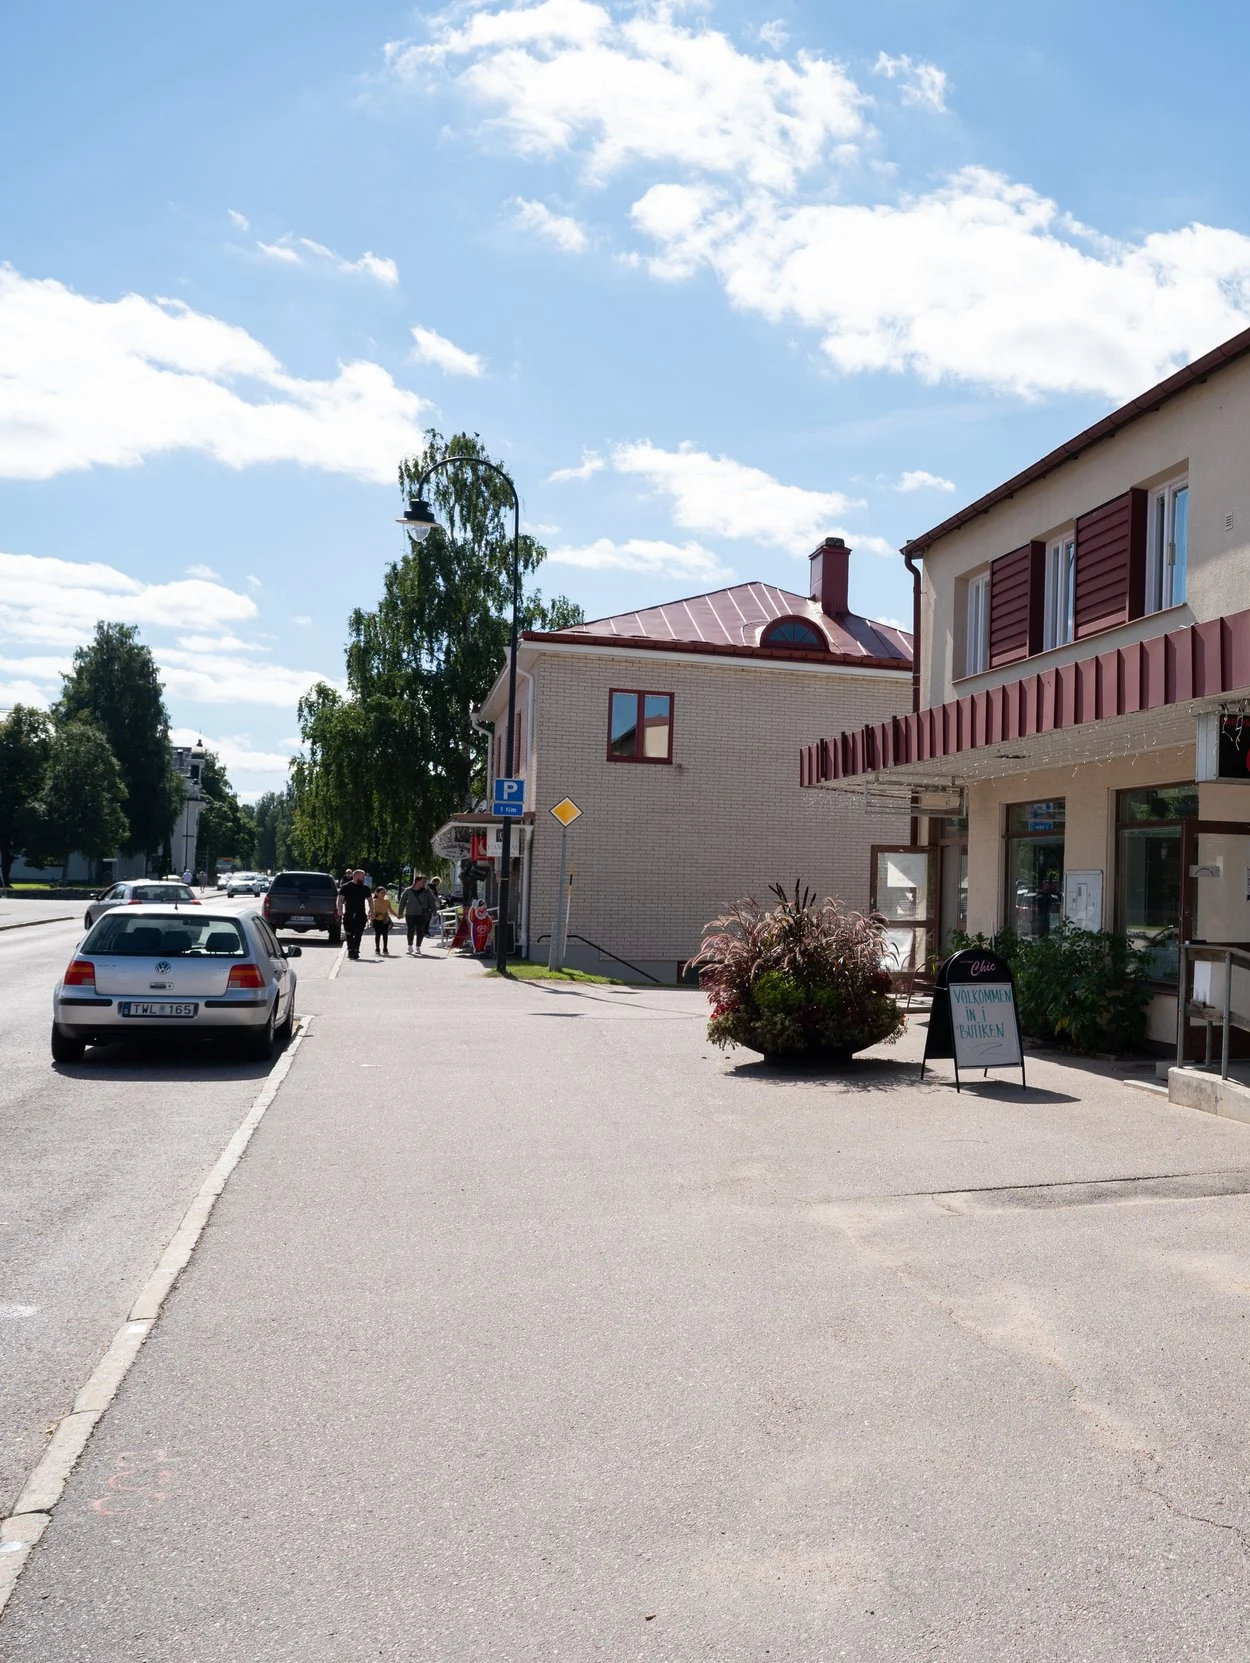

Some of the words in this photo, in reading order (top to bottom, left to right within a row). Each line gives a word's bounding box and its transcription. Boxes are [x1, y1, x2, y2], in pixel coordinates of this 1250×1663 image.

[503, 781, 518, 800] P
[970, 959, 997, 977] Chic
[133, 1004, 157, 1014] TWL
[169, 1004, 191, 1015] 165
